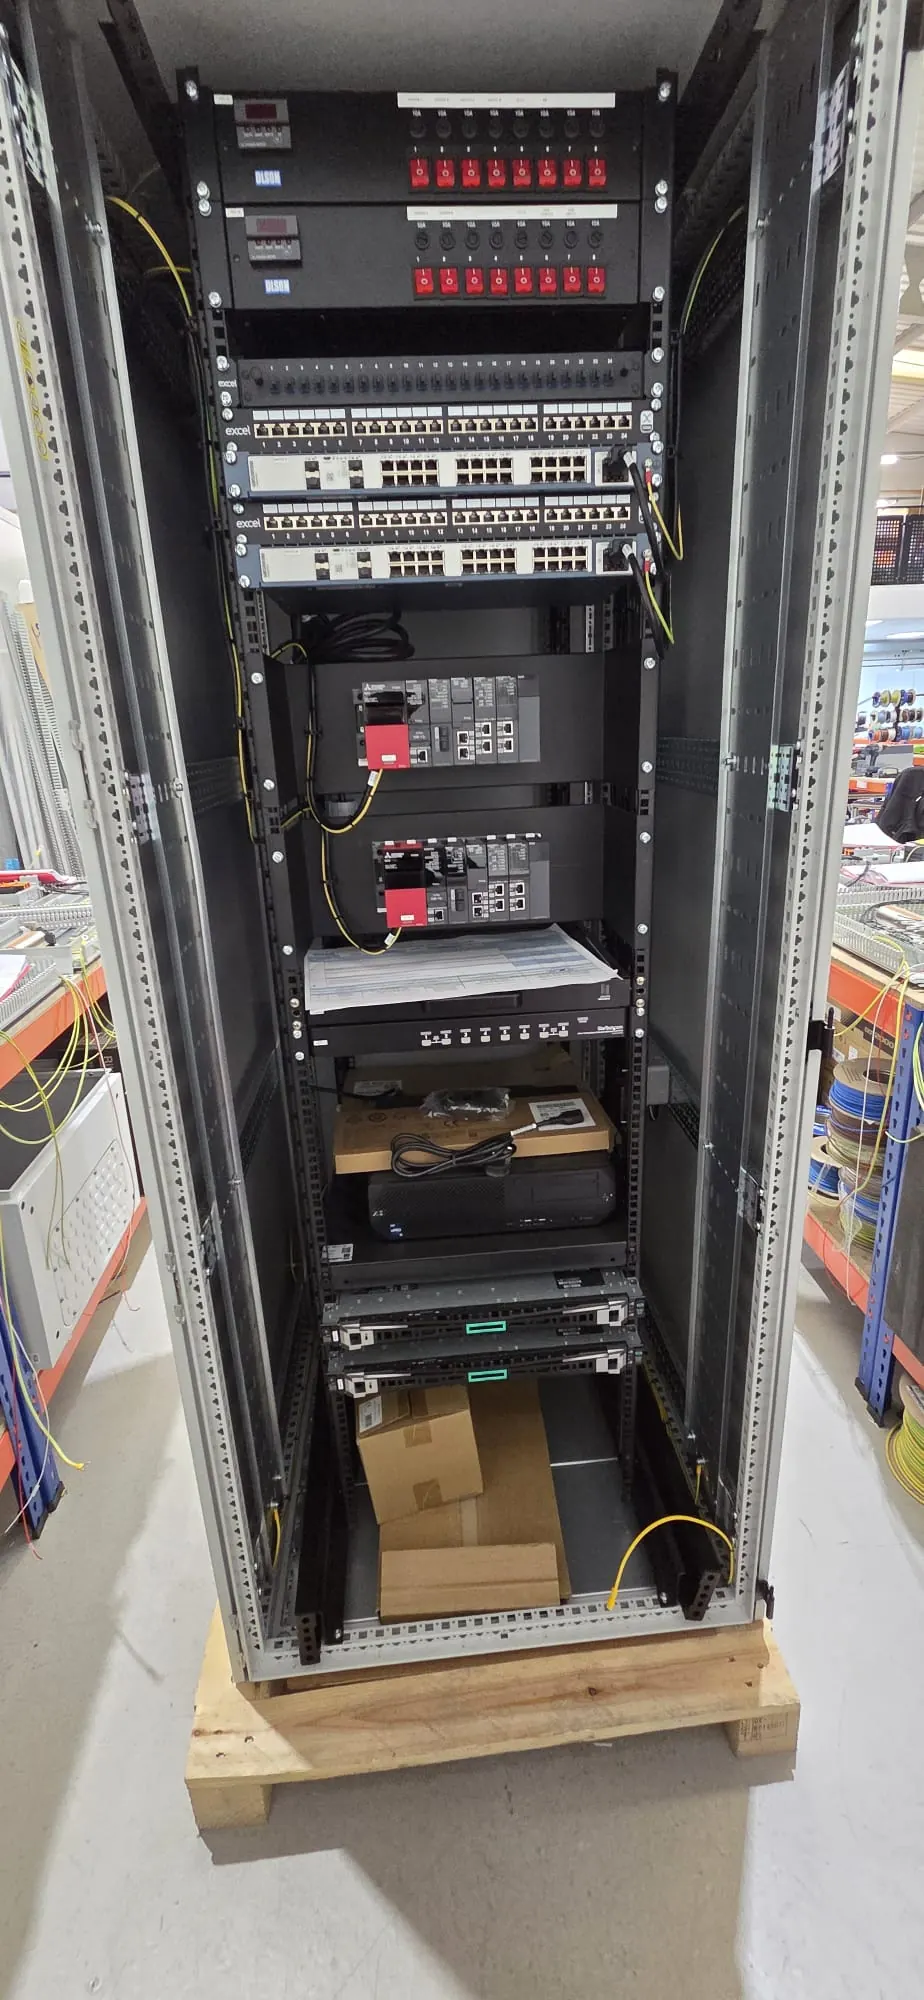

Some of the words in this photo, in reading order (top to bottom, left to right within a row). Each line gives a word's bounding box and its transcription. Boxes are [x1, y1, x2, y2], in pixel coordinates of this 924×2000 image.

[255, 170, 281, 186] OLSON
[265, 279, 290, 294] OLSON
[218, 380, 237, 389] excel
[225, 425, 251, 437] excel
[236, 518, 261, 529] excel
